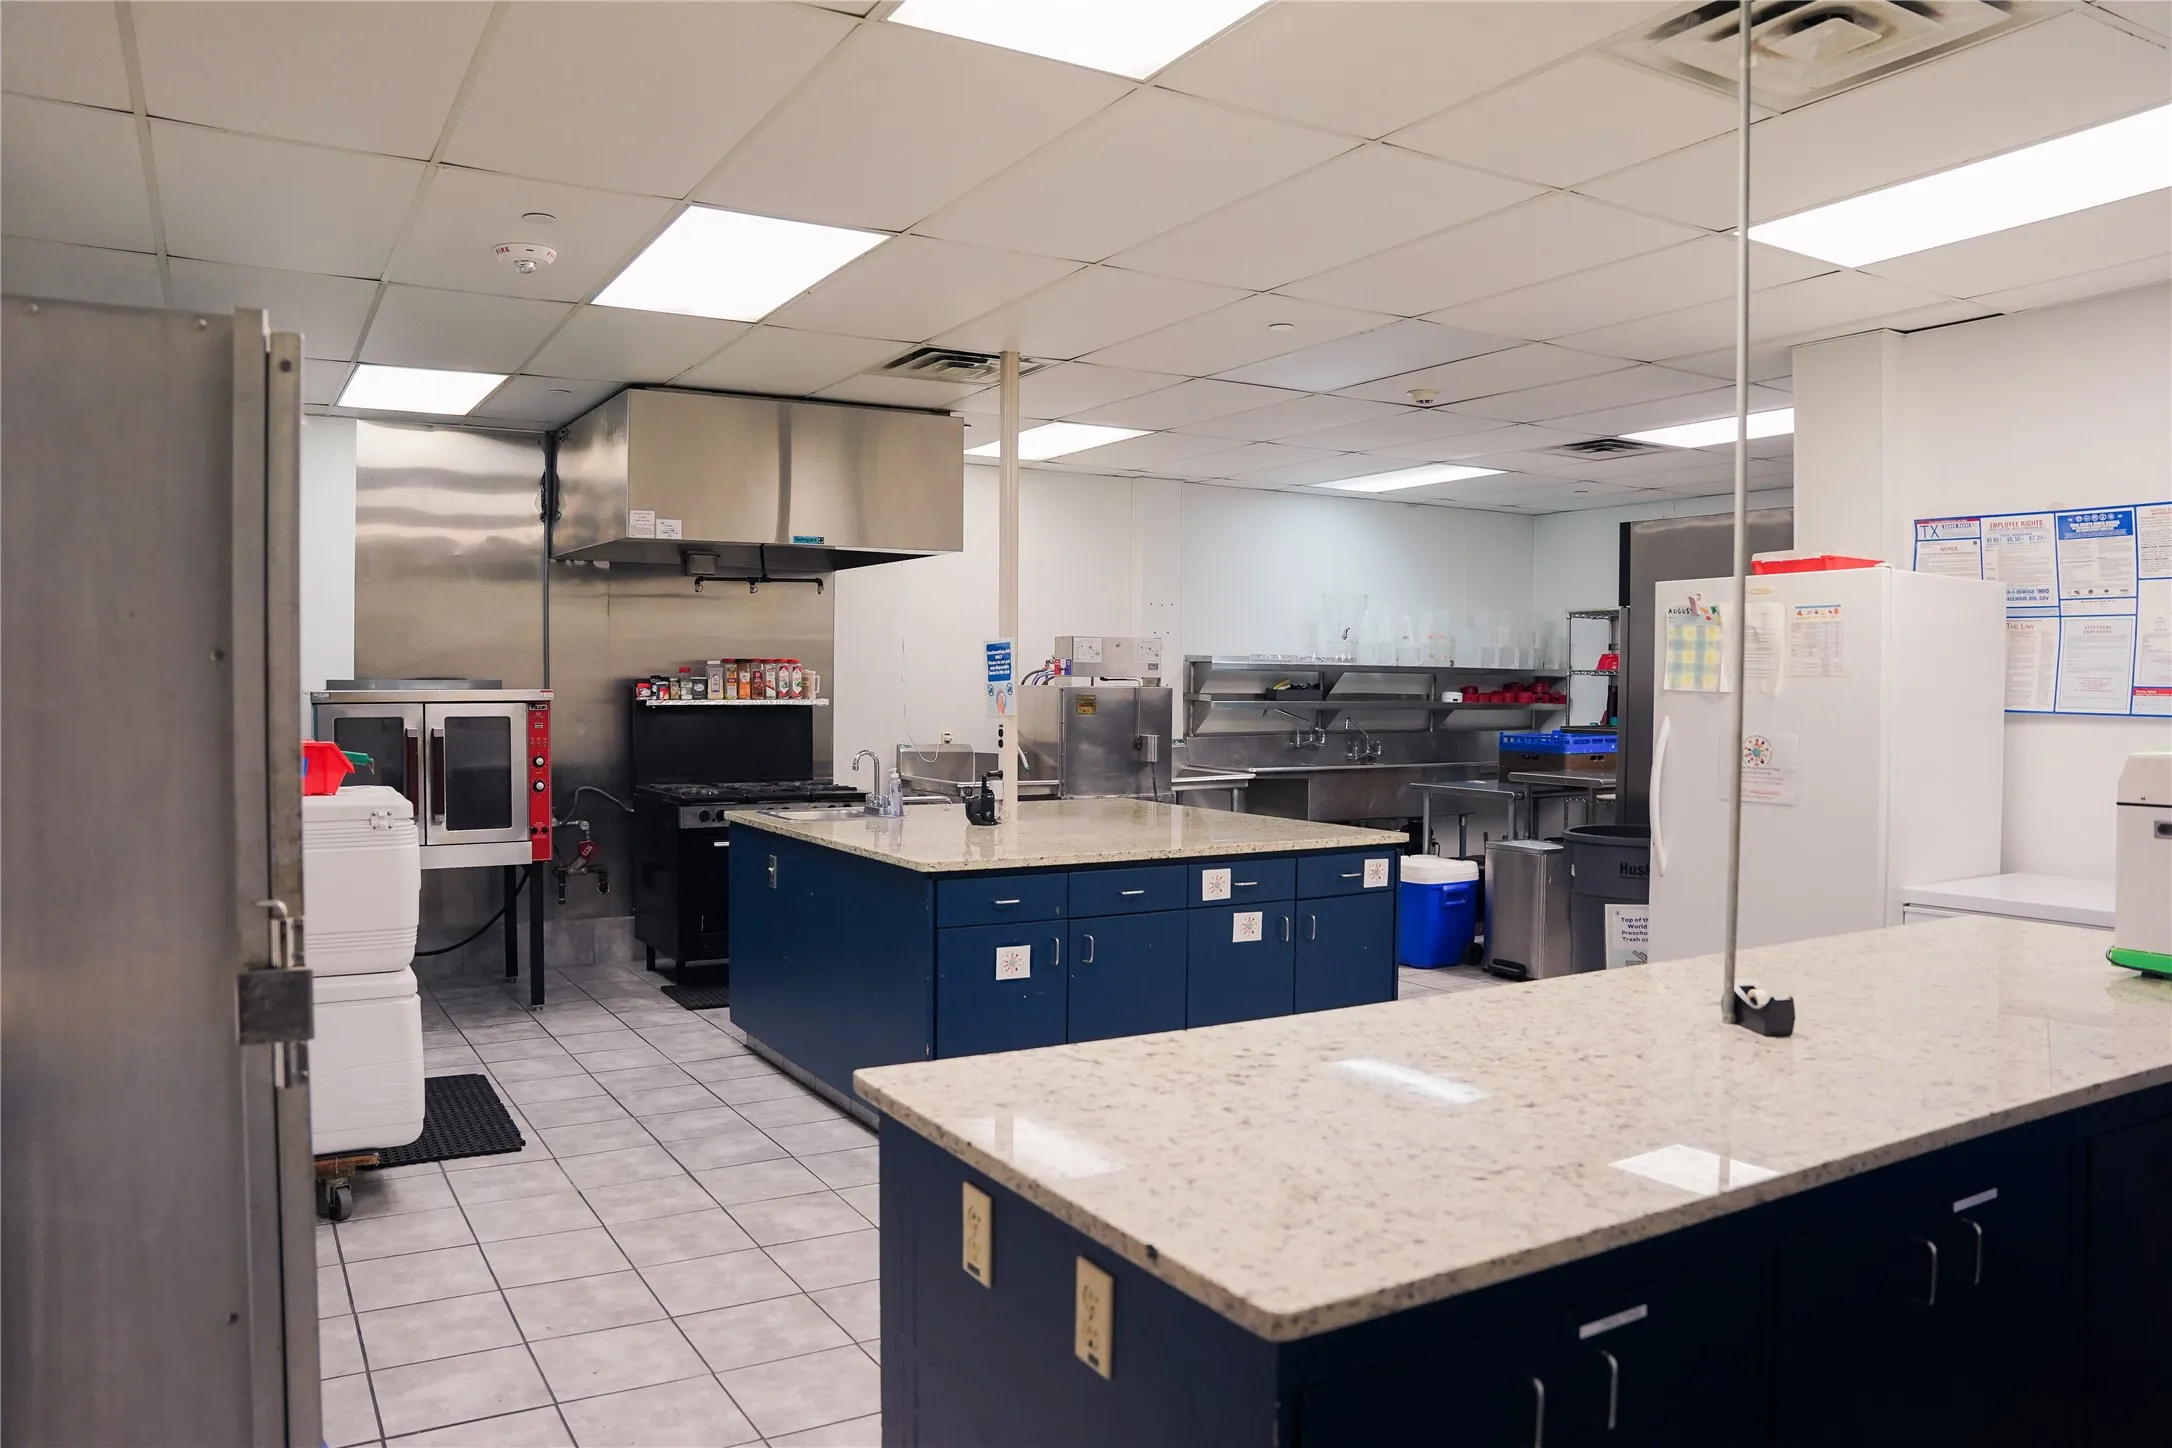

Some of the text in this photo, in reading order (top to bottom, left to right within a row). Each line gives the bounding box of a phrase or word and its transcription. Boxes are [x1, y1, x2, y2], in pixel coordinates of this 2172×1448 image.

[496, 246, 511, 255] FIRE
[1989, 521, 2019, 529] EMPLOYEE
[2020, 519, 2044, 527] RIGHTS
[1919, 524, 1940, 539] TX
[1668, 607, 1694, 615] AUGUS
[1620, 862, 1649, 876] Hus
